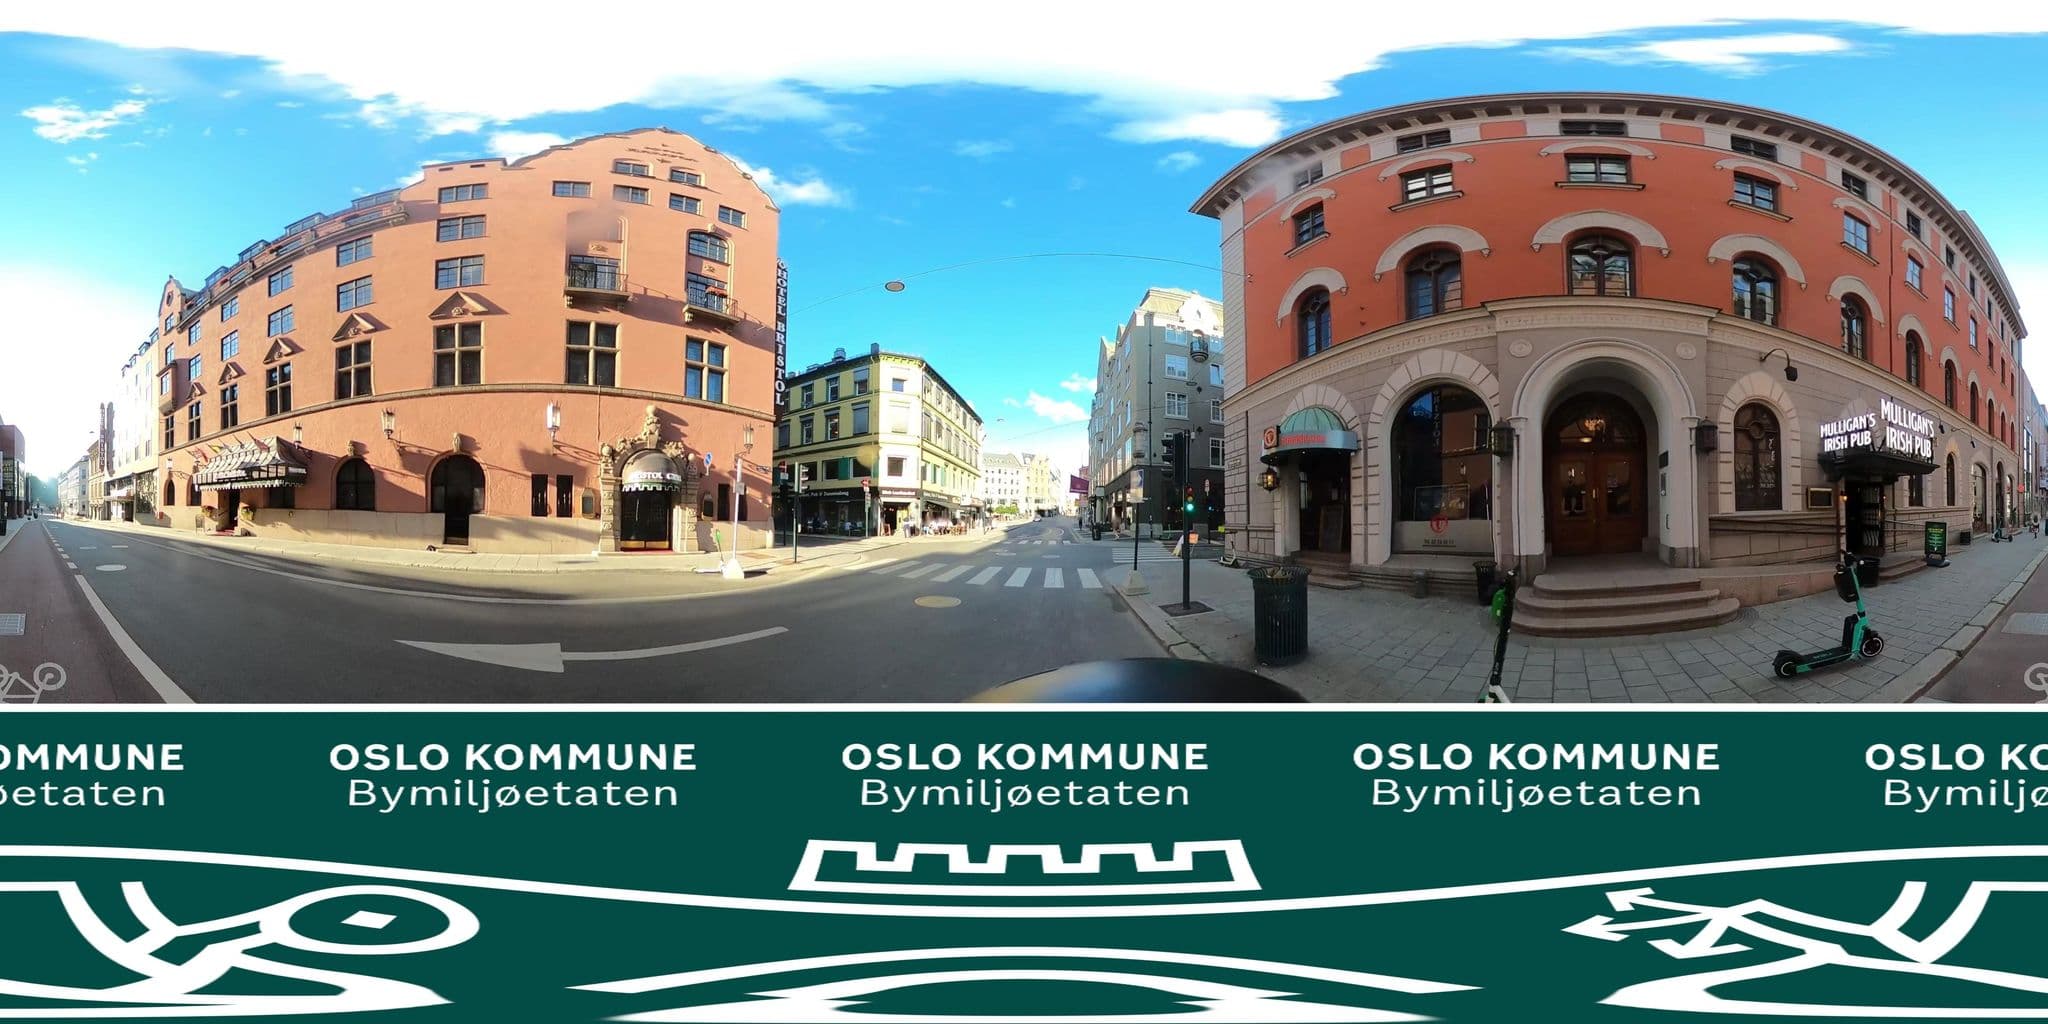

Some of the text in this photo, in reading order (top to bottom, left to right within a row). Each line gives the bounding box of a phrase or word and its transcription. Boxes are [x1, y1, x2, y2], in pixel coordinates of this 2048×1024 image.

[775, 269, 787, 406] HOTEL BRISTOL
[1820, 412, 1877, 438] MULLIGAN'S
[1880, 398, 1935, 438] MULLIGAN'S
[1824, 430, 1872, 452] IRISH PUB
[1886, 426, 1932, 458] IRISH PUB
